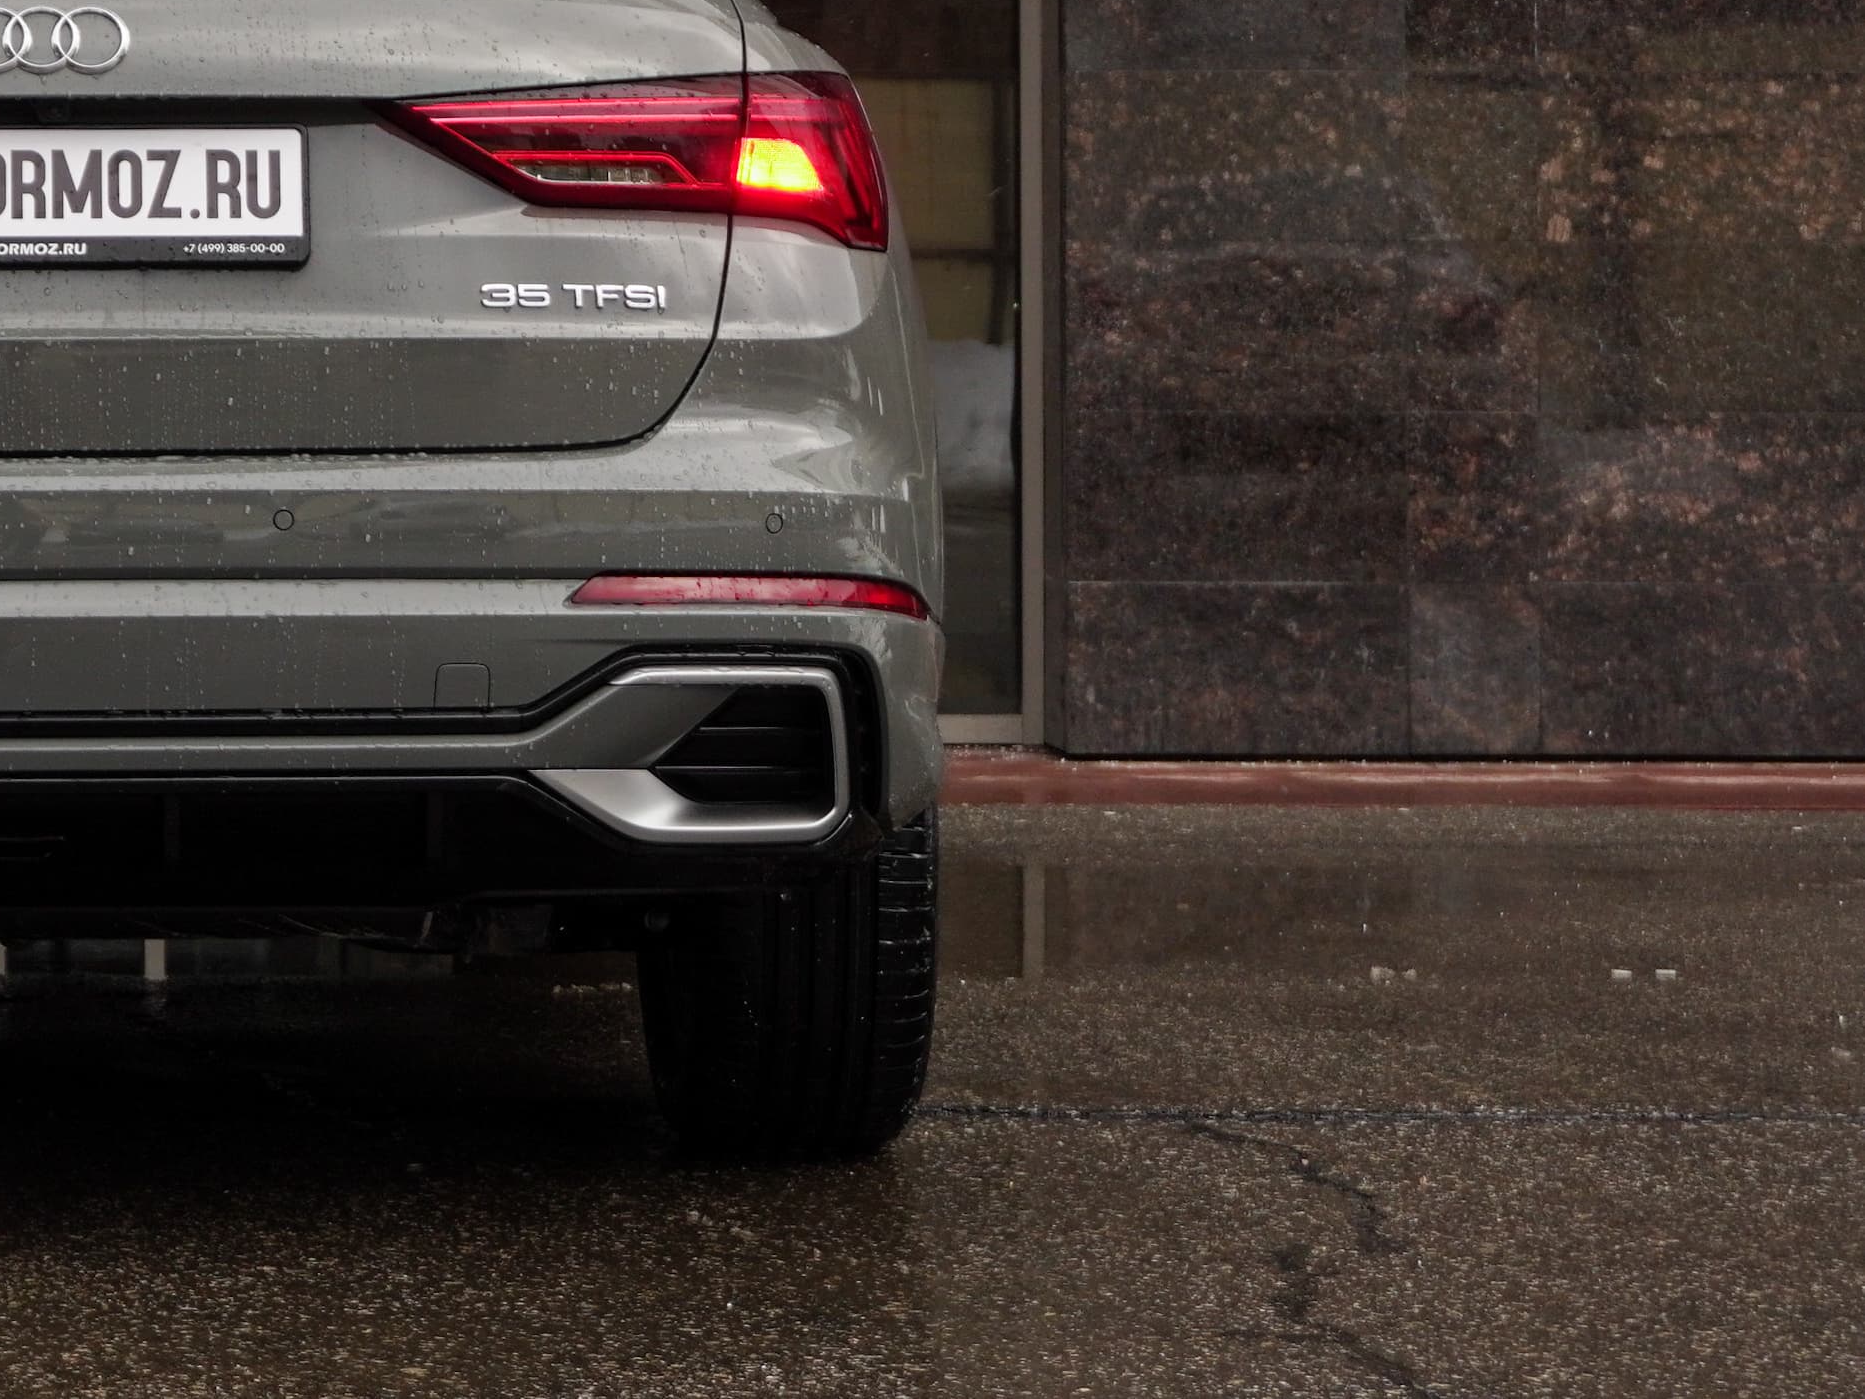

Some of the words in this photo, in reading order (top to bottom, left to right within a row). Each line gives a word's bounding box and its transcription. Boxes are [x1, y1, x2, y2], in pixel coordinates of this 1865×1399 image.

[183, 243, 195, 253] +7
[197, 242, 225, 254] (499)
[226, 242, 286, 253] 385-00-00
[480, 283, 551, 308] 35
[562, 283, 667, 309] TFSI
